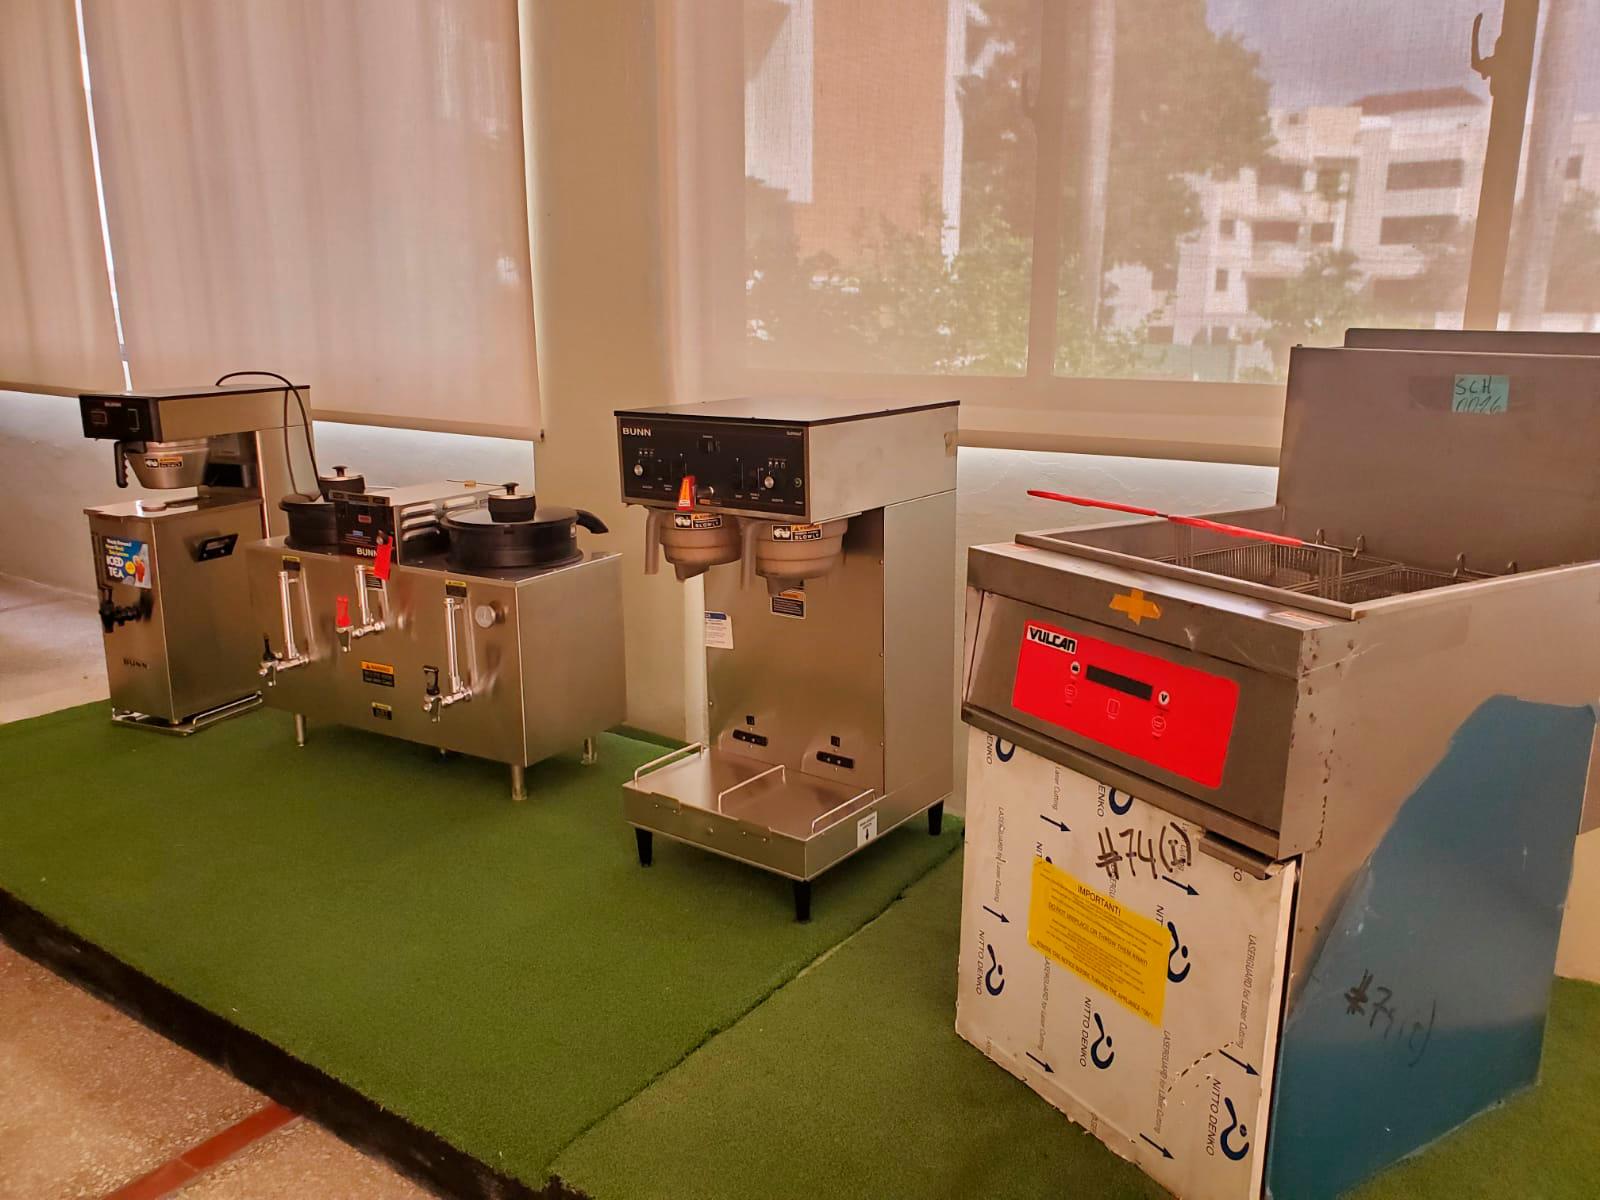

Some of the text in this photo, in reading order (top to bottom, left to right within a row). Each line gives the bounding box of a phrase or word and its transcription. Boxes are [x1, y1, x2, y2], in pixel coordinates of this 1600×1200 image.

[1455, 375, 1492, 395] SCH
[622, 427, 652, 437] BUNN
[106, 555, 124, 568] ICED
[108, 566, 125, 578] TEA
[1029, 626, 1077, 653] VULCAN
[1077, 885, 1121, 917] IMPORTANT!
[1243, 934, 1257, 988] LASERGUARD
[976, 961, 984, 995] DENKO
[1080, 998, 1092, 1067] NITTO DENKO
[1206, 1079, 1221, 1156] NITTO DENKO
